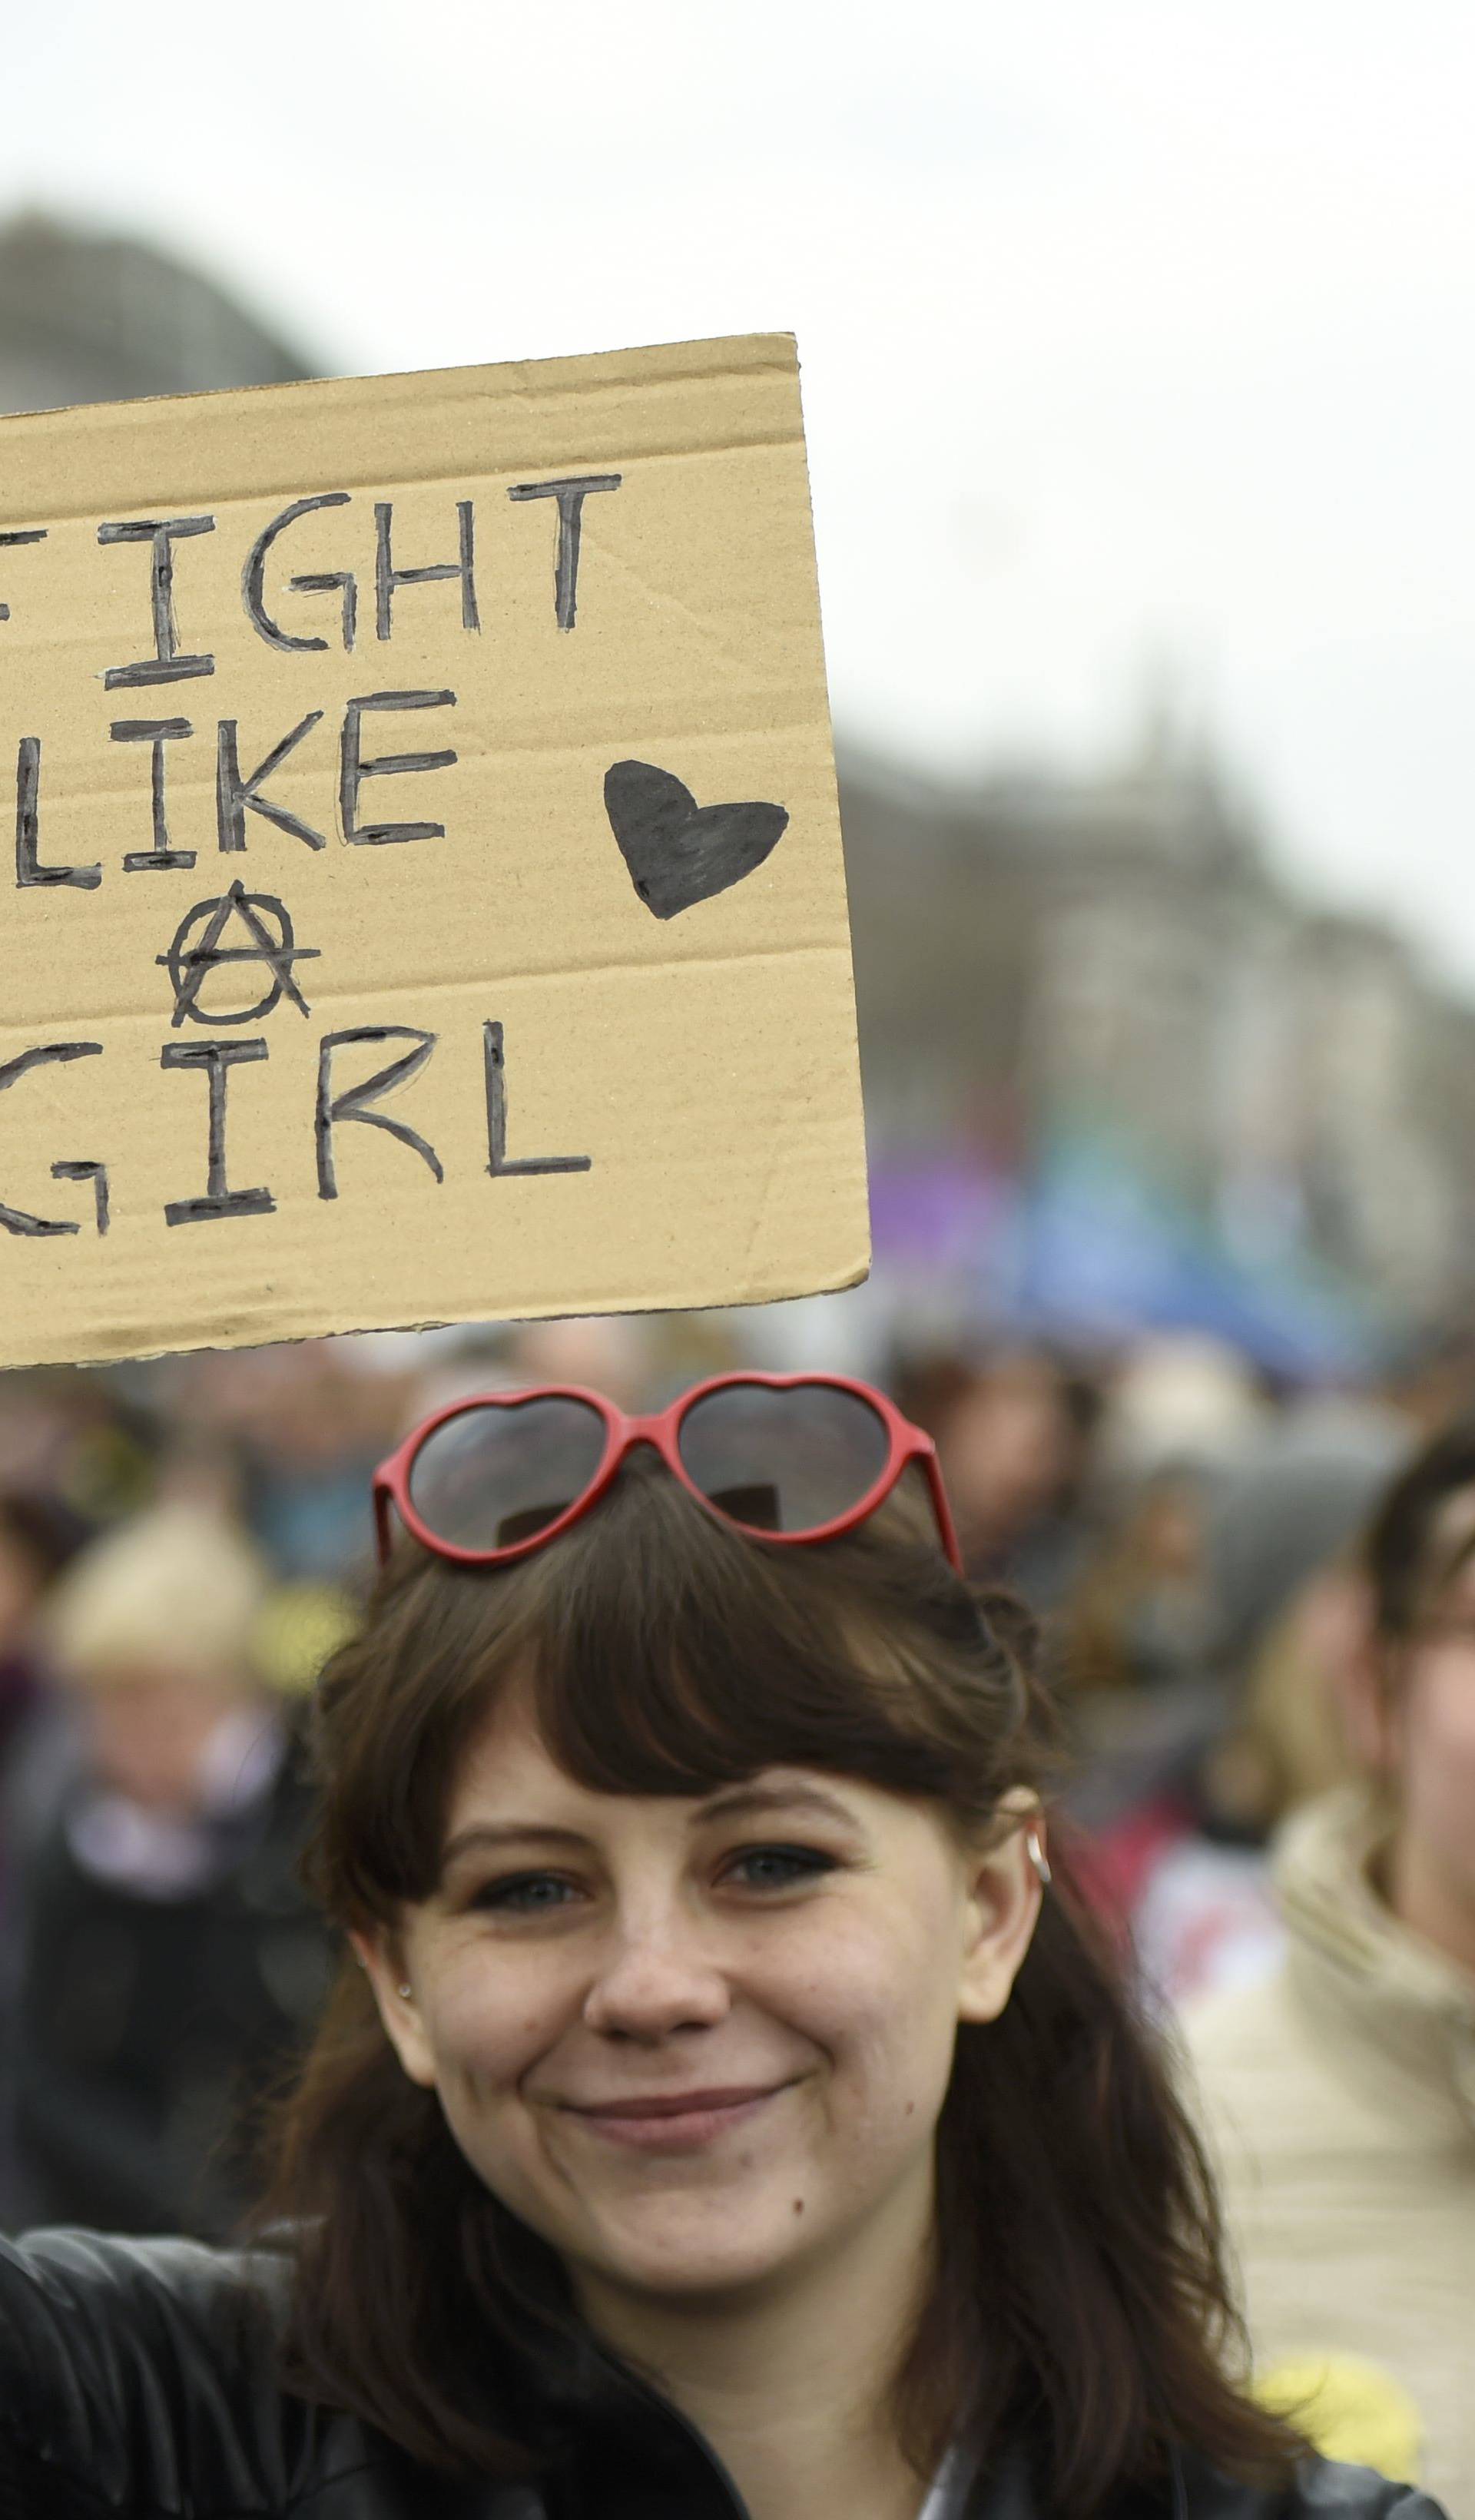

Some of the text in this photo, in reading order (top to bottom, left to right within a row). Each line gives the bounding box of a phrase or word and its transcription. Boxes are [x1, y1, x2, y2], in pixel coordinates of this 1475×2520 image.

[16, 690, 458, 890] LIKE
[155, 880, 321, 1027] A
[0, 1019, 592, 1237] GIRL
